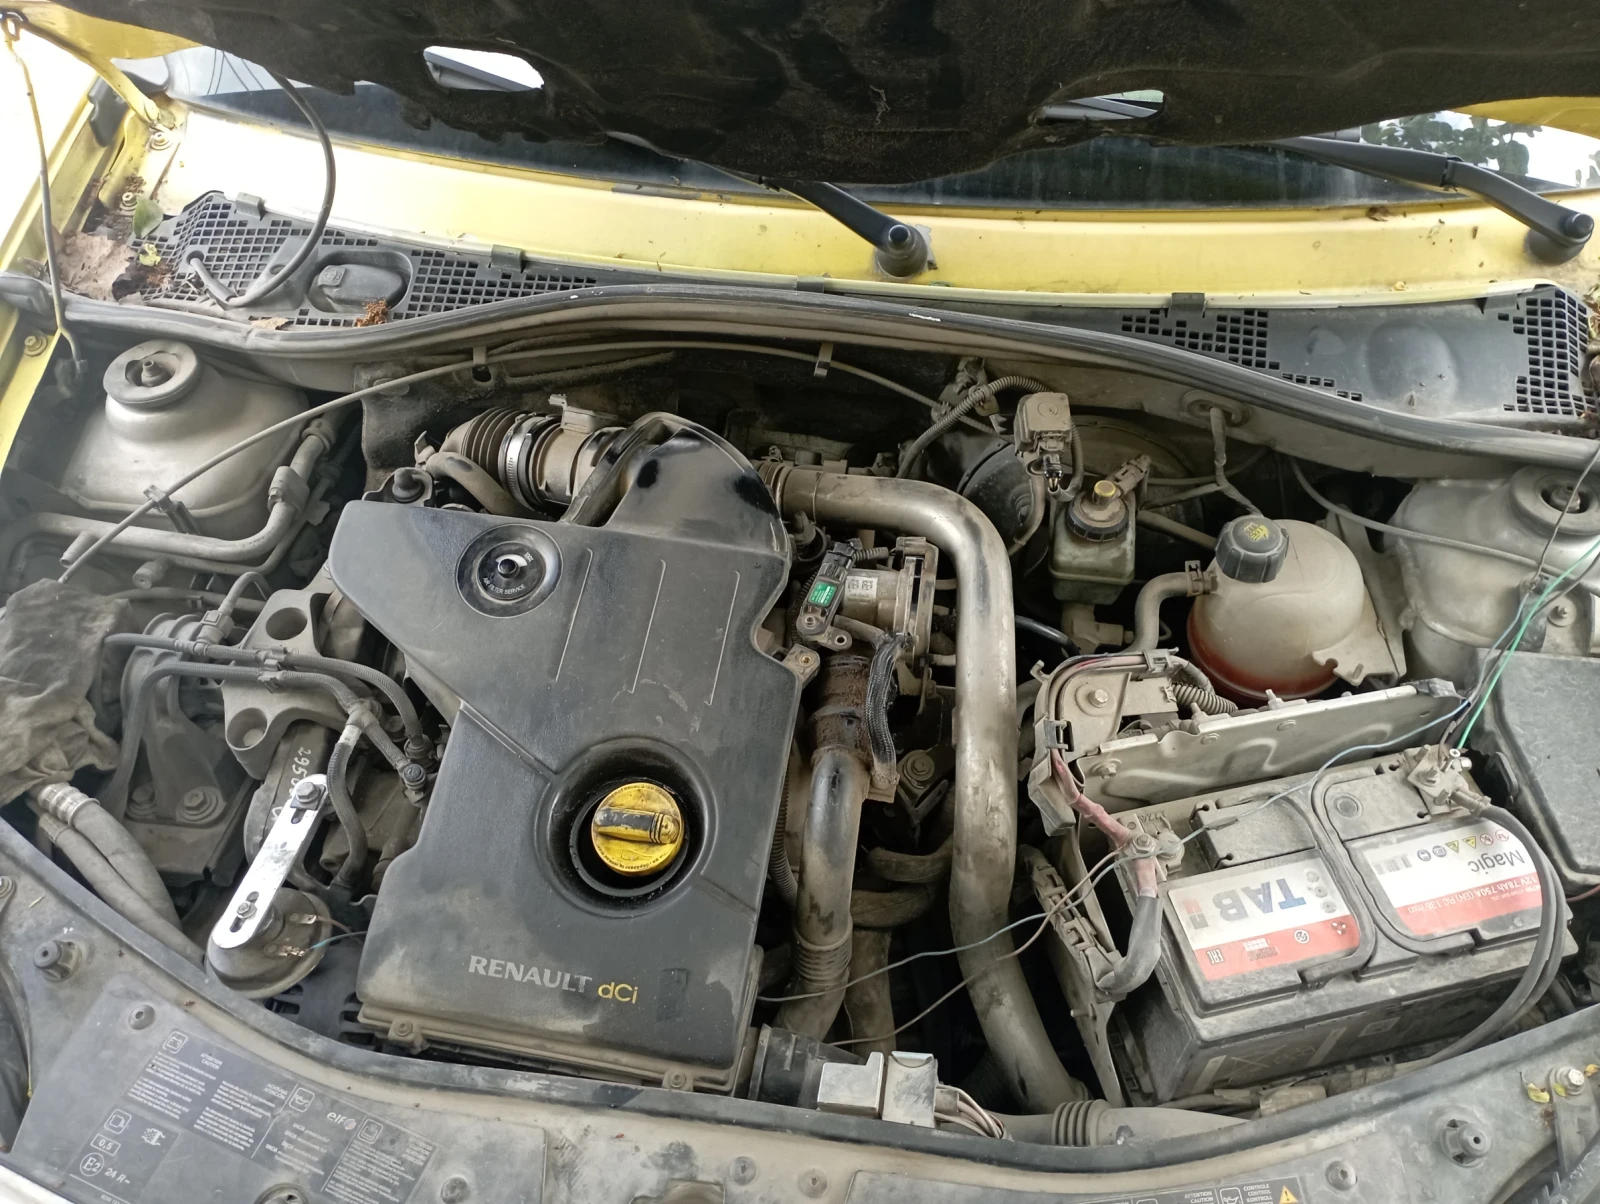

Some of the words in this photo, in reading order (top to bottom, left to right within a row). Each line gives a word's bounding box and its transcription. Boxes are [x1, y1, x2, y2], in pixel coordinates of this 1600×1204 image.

[488, 584, 503, 594] FILTER
[504, 584, 525, 594] SERVICE
[1468, 849, 1526, 875] Magic
[1497, 879, 1520, 892] 78Ah
[1521, 875, 1538, 886] 12V
[1456, 890, 1475, 902] (EN)
[1475, 884, 1498, 898] 750A
[1212, 878, 1307, 922] TAB
[1444, 895, 1456, 905] RC
[1407, 903, 1425, 914] min
[468, 954, 593, 993] RENAULT
[597, 981, 639, 1004] dCi
[201, 1058, 220, 1070] CAUTION
[326, 1111, 347, 1124] elf
[98, 1138, 114, 1151] 0,5
[82, 1156, 101, 1172] E2
[104, 1167, 118, 1179] 24
[1184, 1190, 1212, 1199] ATTENTION
[1247, 1189, 1272, 1197] CONTROL
